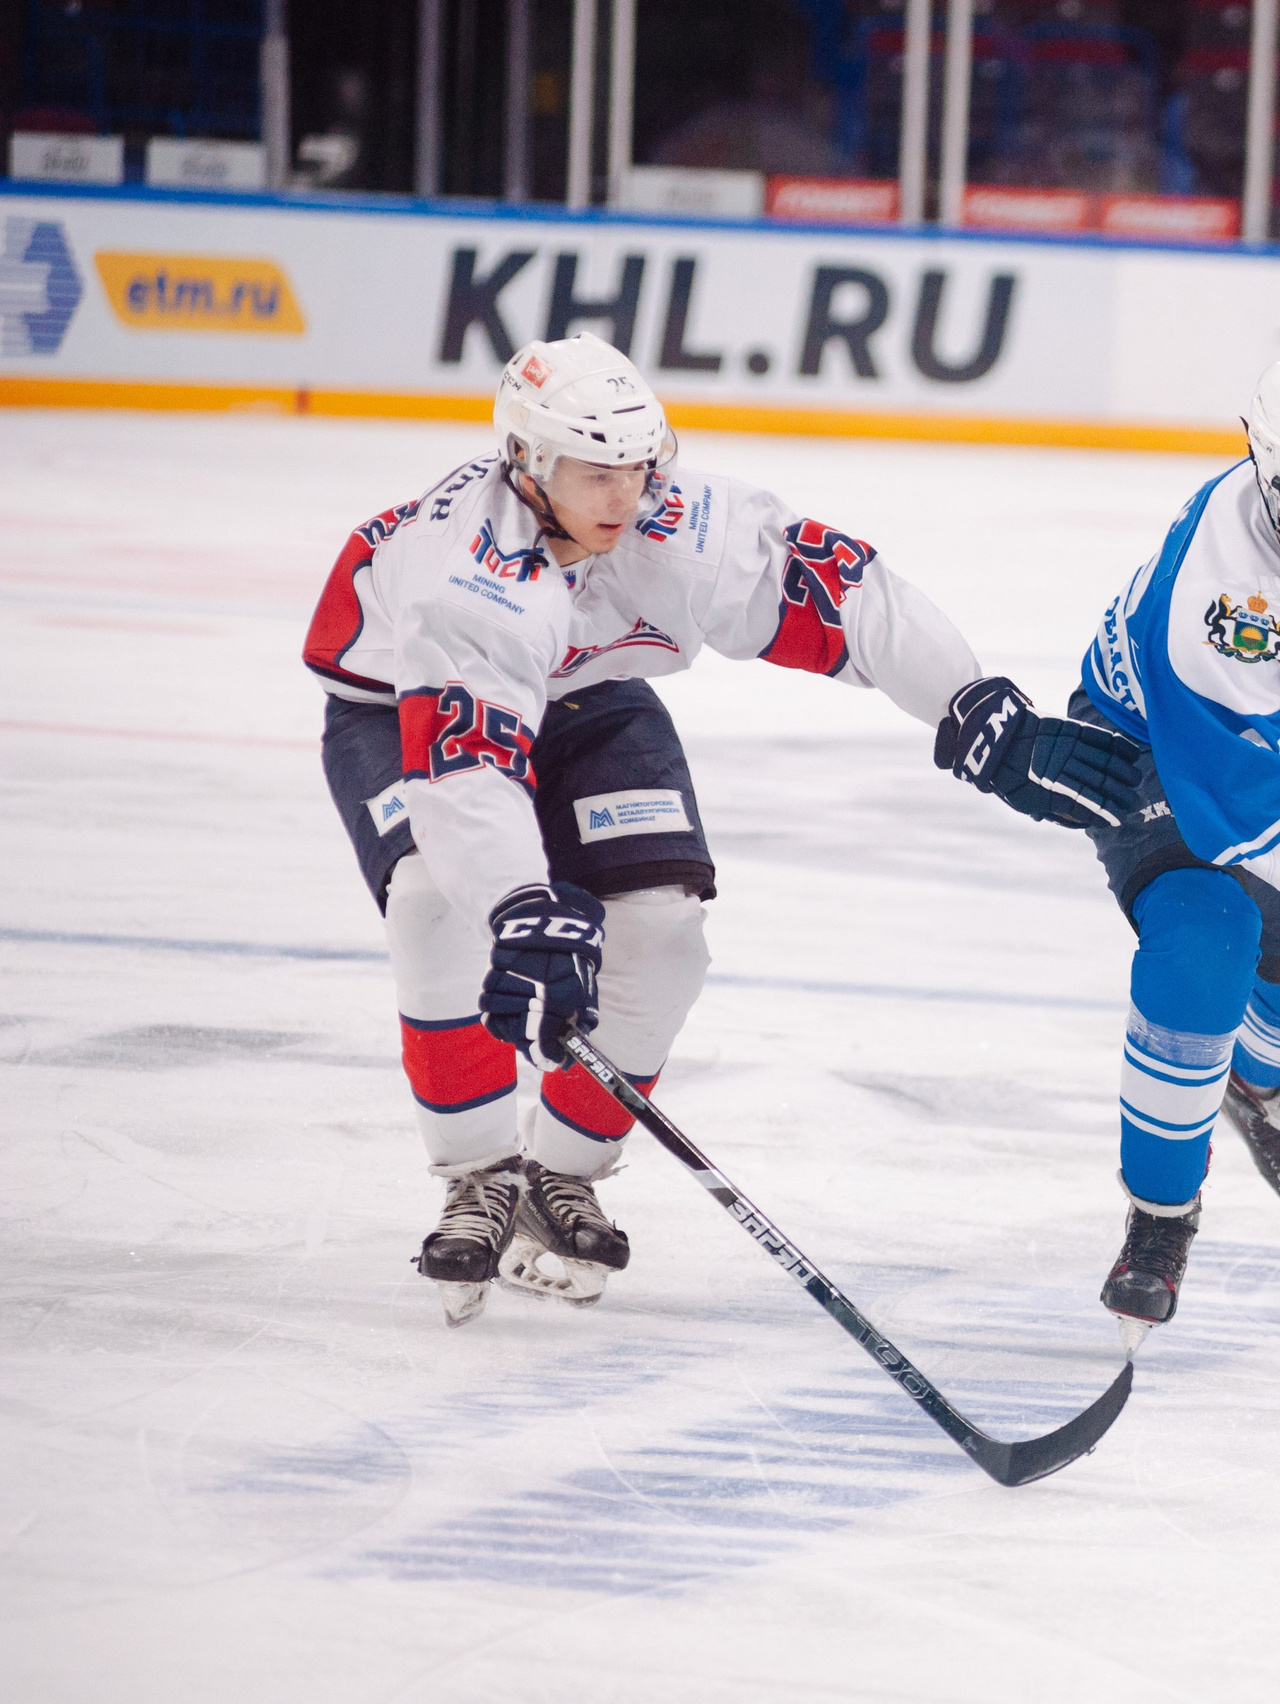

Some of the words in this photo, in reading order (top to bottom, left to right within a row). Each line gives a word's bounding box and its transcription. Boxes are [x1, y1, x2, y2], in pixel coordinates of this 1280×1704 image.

[436, 247, 1018, 383] KHL.RU
[689, 501, 700, 531] MINING
[701, 484, 713, 522] COMPANY
[695, 520, 708, 554] UNITED
[448, 575, 480, 594] UNITED
[480, 588, 525, 616] COMPANY
[472, 573, 506, 594] MINING
[428, 681, 533, 784] 25
[960, 696, 1018, 782] CM
